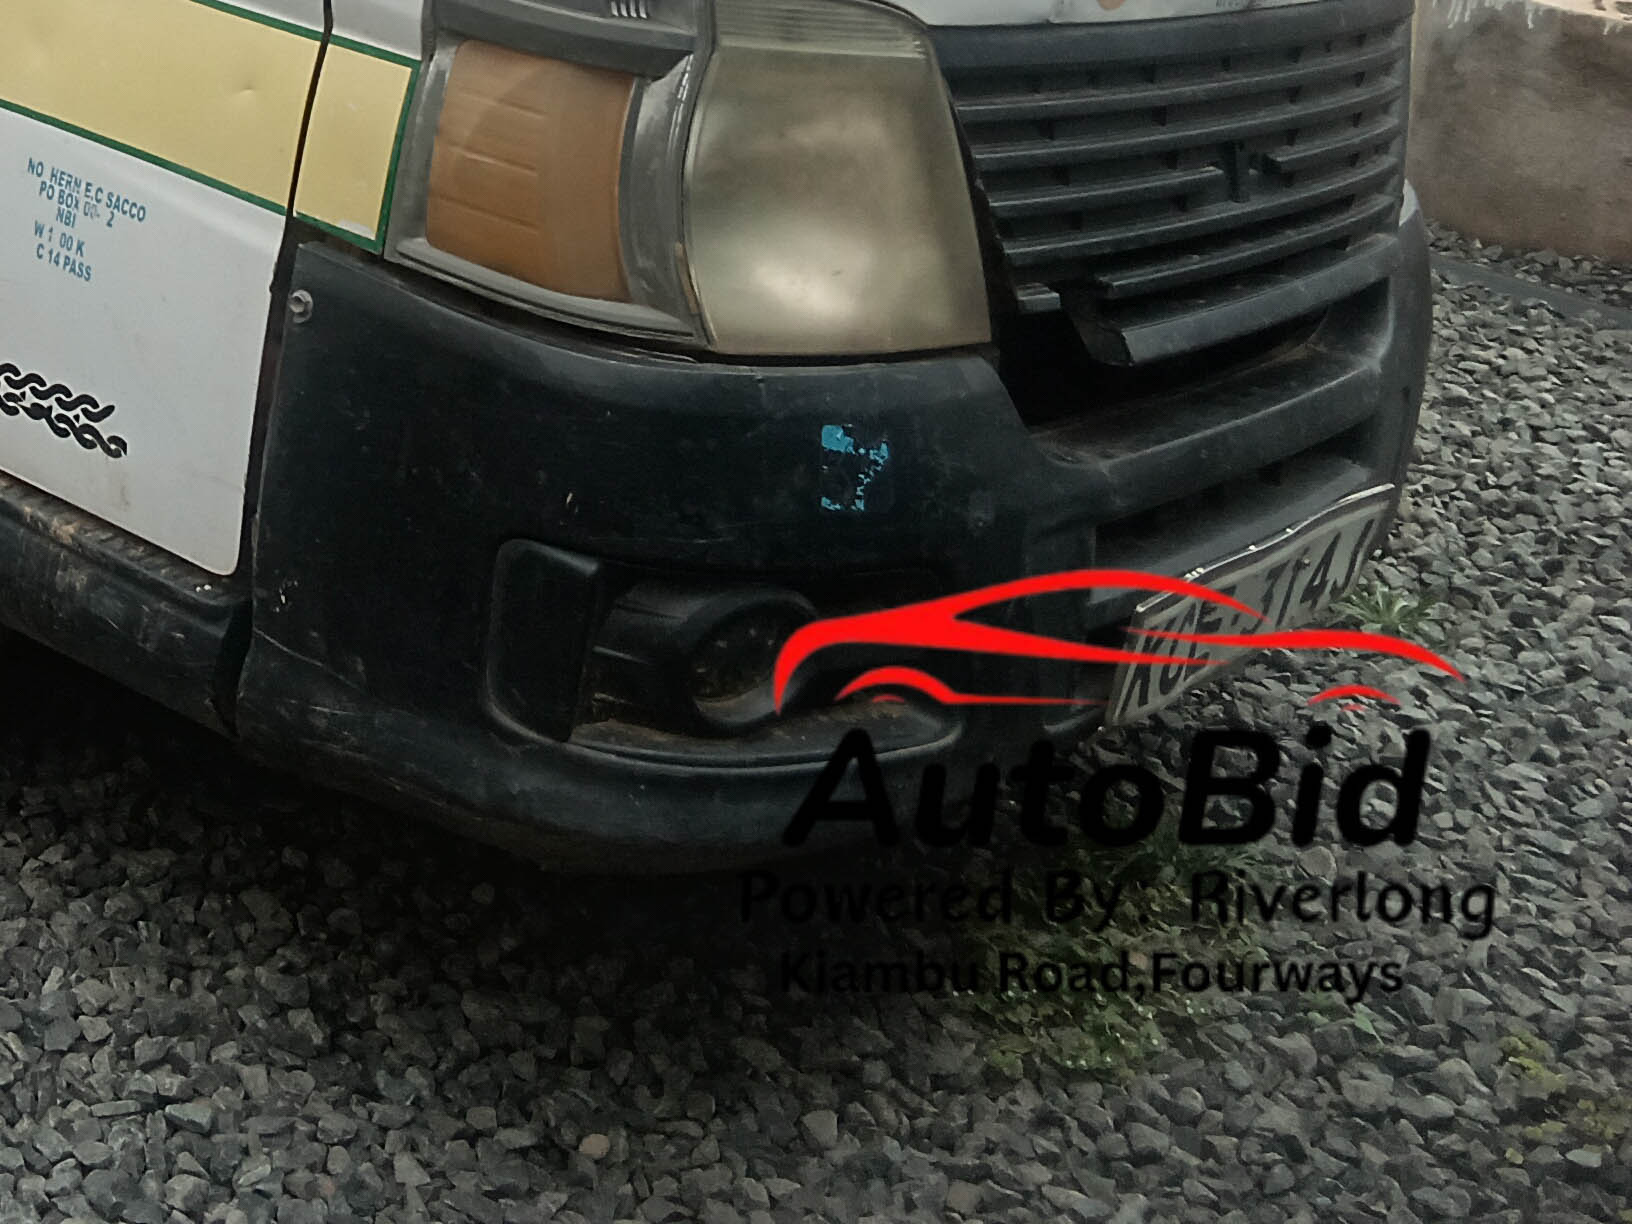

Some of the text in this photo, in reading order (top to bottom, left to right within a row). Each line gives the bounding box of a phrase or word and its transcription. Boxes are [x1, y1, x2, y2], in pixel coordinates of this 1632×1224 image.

[39, 181, 55, 200] PO
[57, 189, 79, 211] BOX
[106, 191, 147, 222] SACCO
[48, 248, 61, 267] 14
[62, 255, 92, 282] PASS
